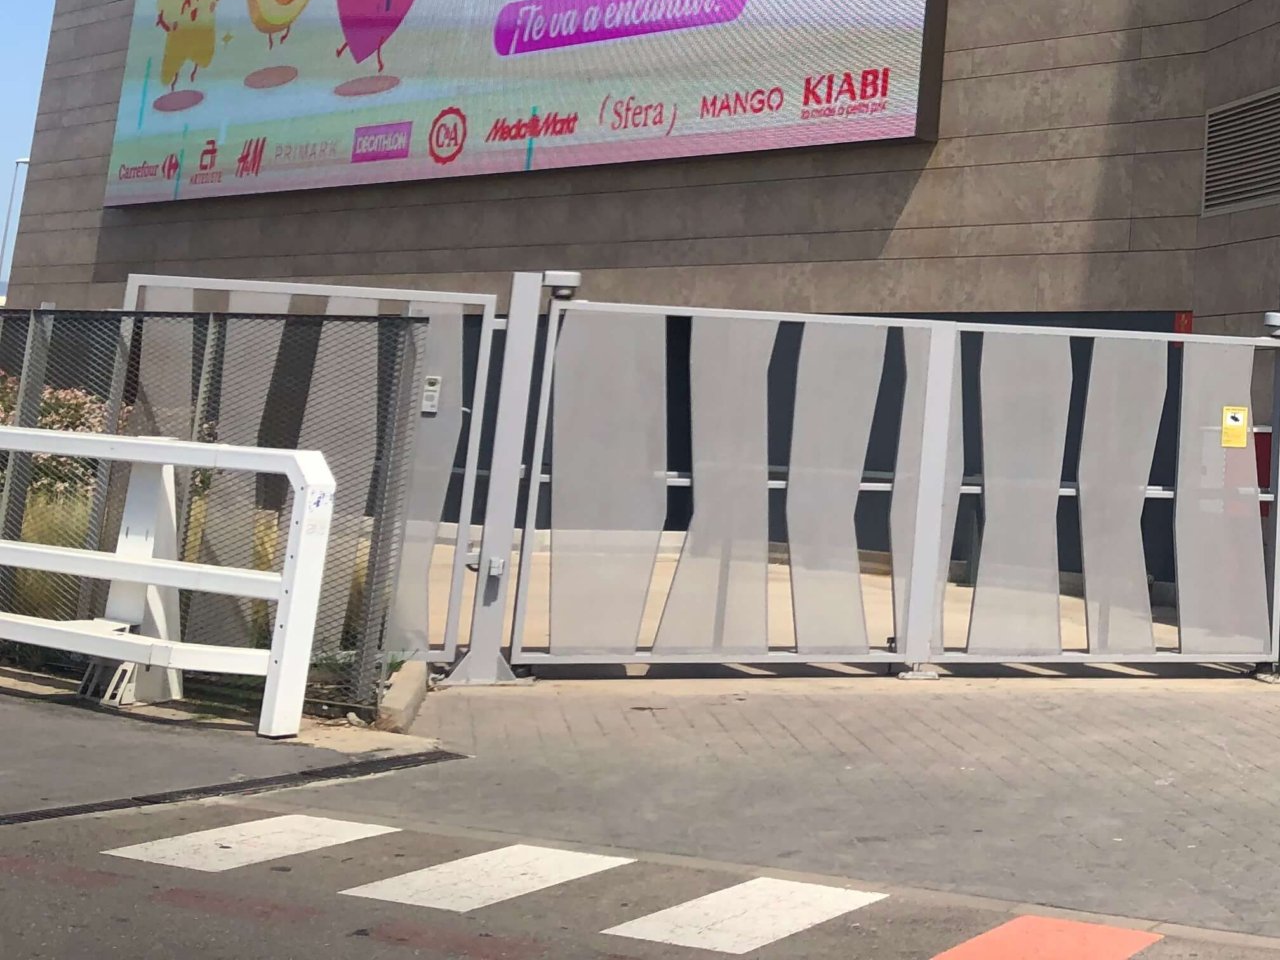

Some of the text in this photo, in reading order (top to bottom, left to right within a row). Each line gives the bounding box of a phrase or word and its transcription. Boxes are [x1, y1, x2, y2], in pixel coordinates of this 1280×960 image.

[551, 6, 577, 39] va
[582, 5, 599, 33] a
[700, 86, 784, 120] MANGO
[802, 66, 890, 106] KIABI
